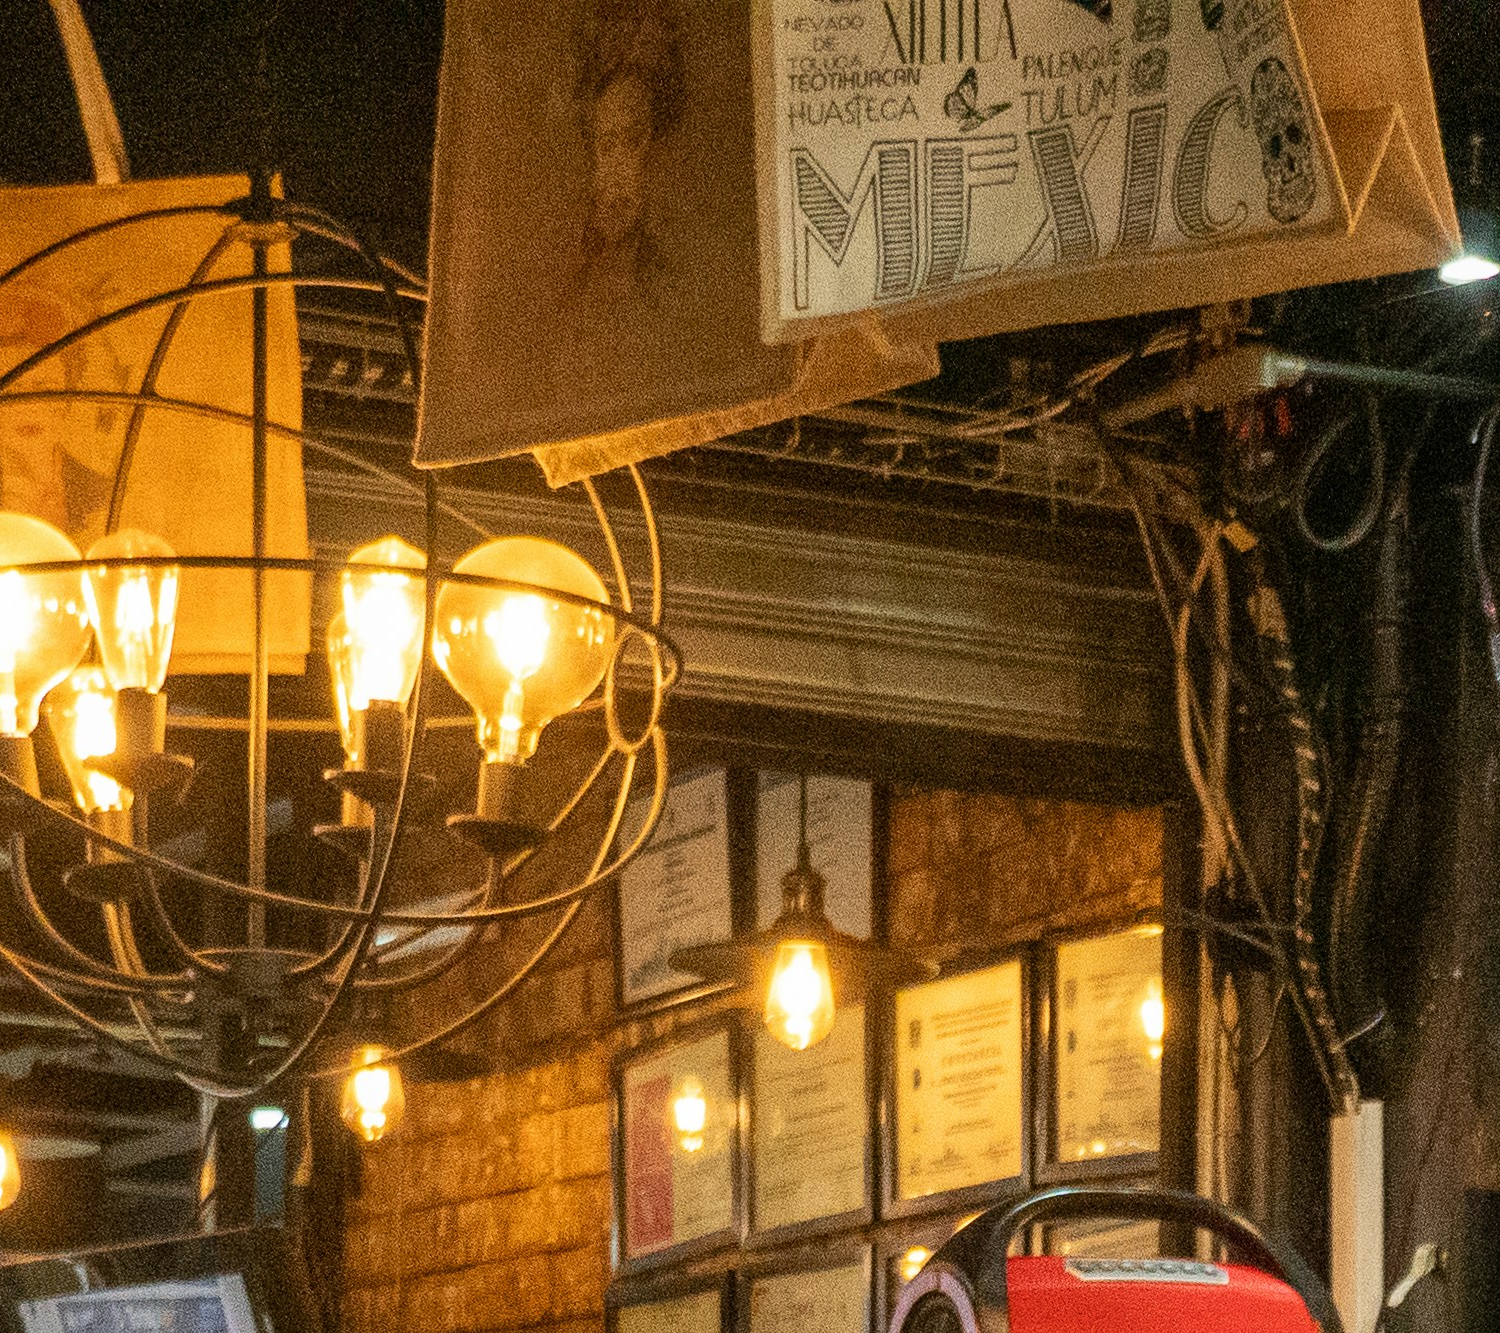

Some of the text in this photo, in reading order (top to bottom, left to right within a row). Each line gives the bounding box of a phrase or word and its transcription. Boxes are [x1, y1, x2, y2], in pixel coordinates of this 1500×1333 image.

[787, 67, 922, 93] TEOTIHUACAN
[787, 94, 920, 130] HUASTECA
[1022, 79, 1119, 125] TULUM
